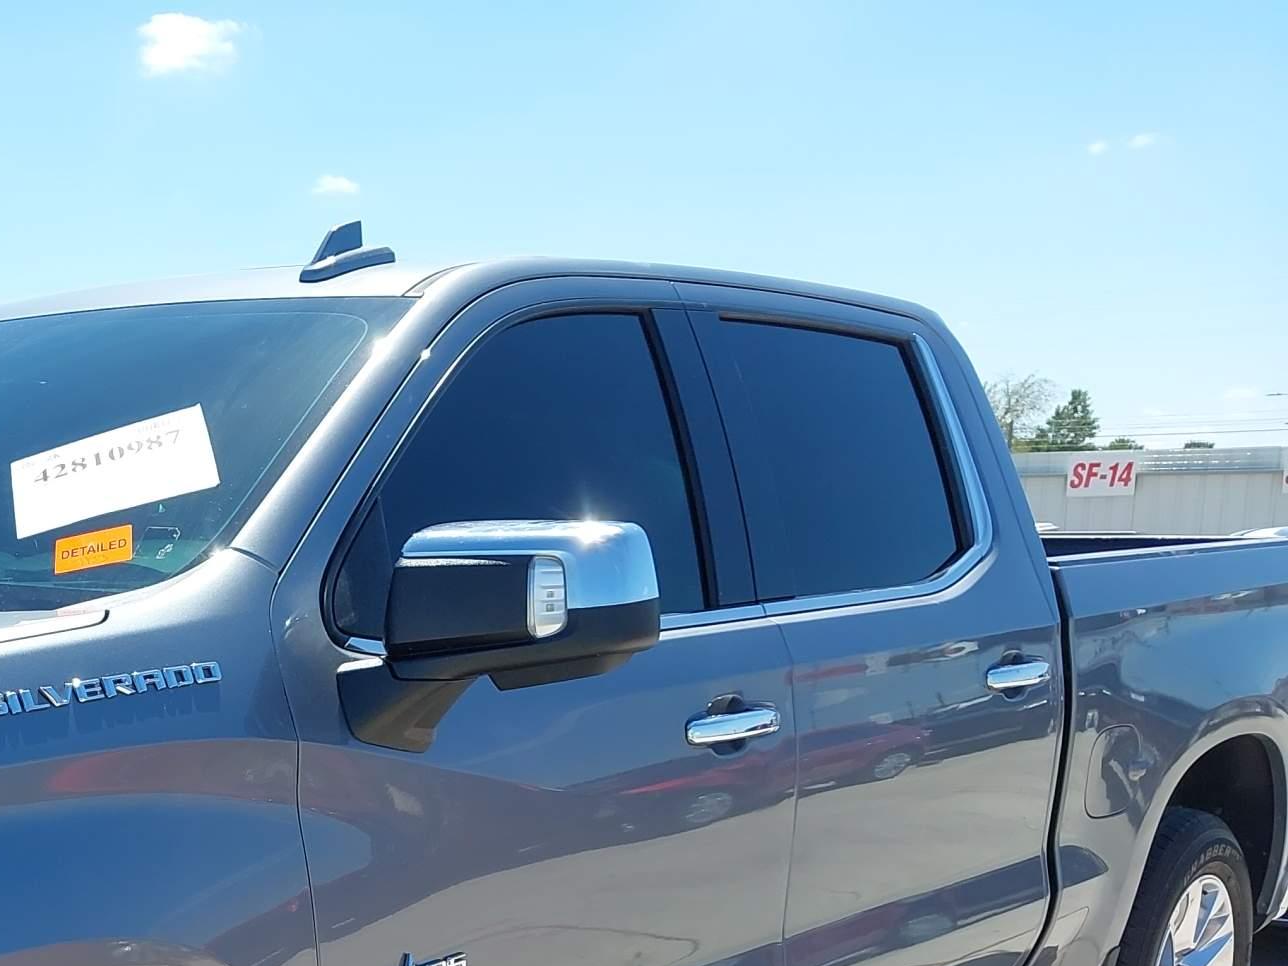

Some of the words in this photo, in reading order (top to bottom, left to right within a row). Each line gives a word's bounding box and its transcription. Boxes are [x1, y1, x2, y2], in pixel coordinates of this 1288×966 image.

[33, 429, 181, 484] 42810987
[1069, 461, 1135, 489] SF-14
[61, 537, 127, 560] DETAILED
